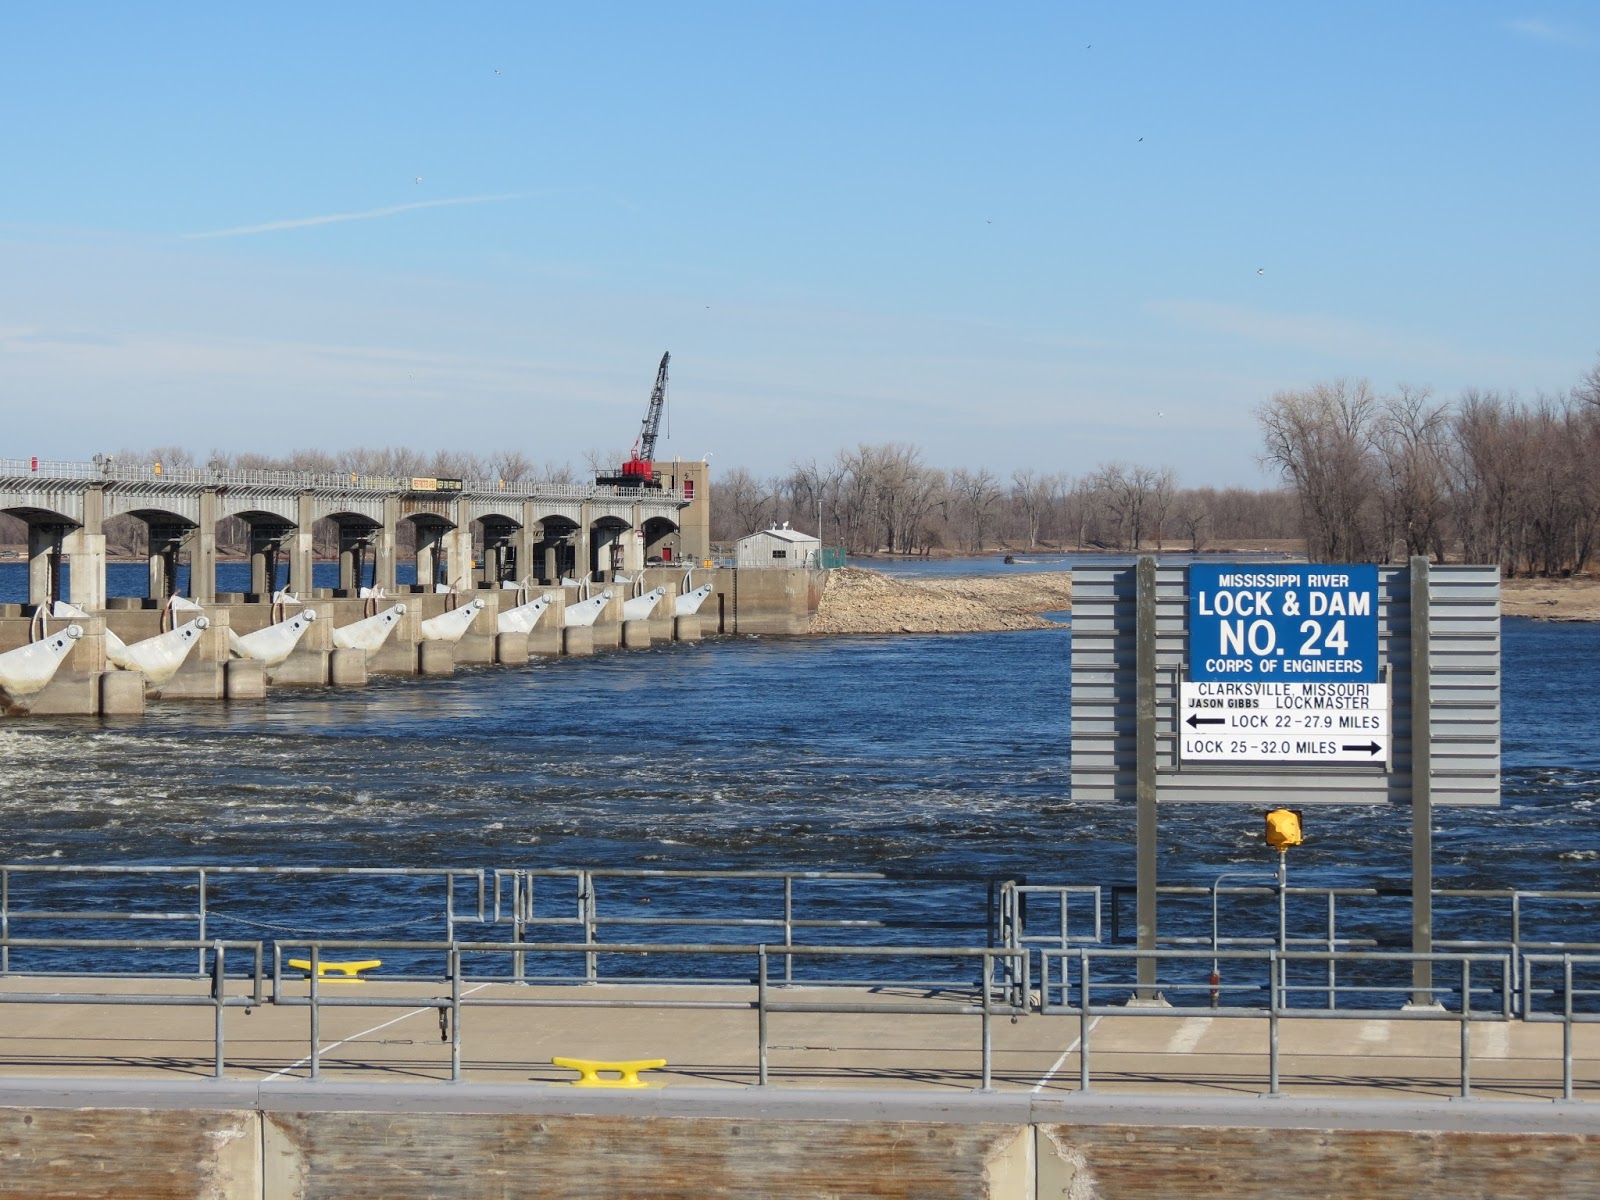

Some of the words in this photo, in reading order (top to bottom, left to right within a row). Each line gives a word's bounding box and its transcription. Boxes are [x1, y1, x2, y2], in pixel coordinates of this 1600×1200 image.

[1219, 574, 1300, 588] MISSISSIPPI
[1308, 574, 1349, 588] RIVER
[1199, 590, 1273, 617] LOCK
[1282, 590, 1300, 617] &
[1309, 591, 1370, 616] DAM
[1220, 619, 1284, 656] NO.
[1300, 620, 1349, 656] 24
[1206, 659, 1253, 673] CORPS
[1260, 659, 1277, 673] OF
[1283, 659, 1363, 673] ENGINEERS
[1199, 683, 1295, 698] CLARKSVILLE,
[1302, 684, 1370, 697] MISSOURI
[1189, 698, 1224, 708] JASON
[1227, 698, 1259, 708] GIBBS
[1276, 697, 1369, 709] LOCKMASTER
[1231, 715, 1268, 728] LOCK
[1339, 716, 1380, 729] MILES
[1186, 740, 1223, 753] LOCK
[1296, 741, 1337, 754] MILES
